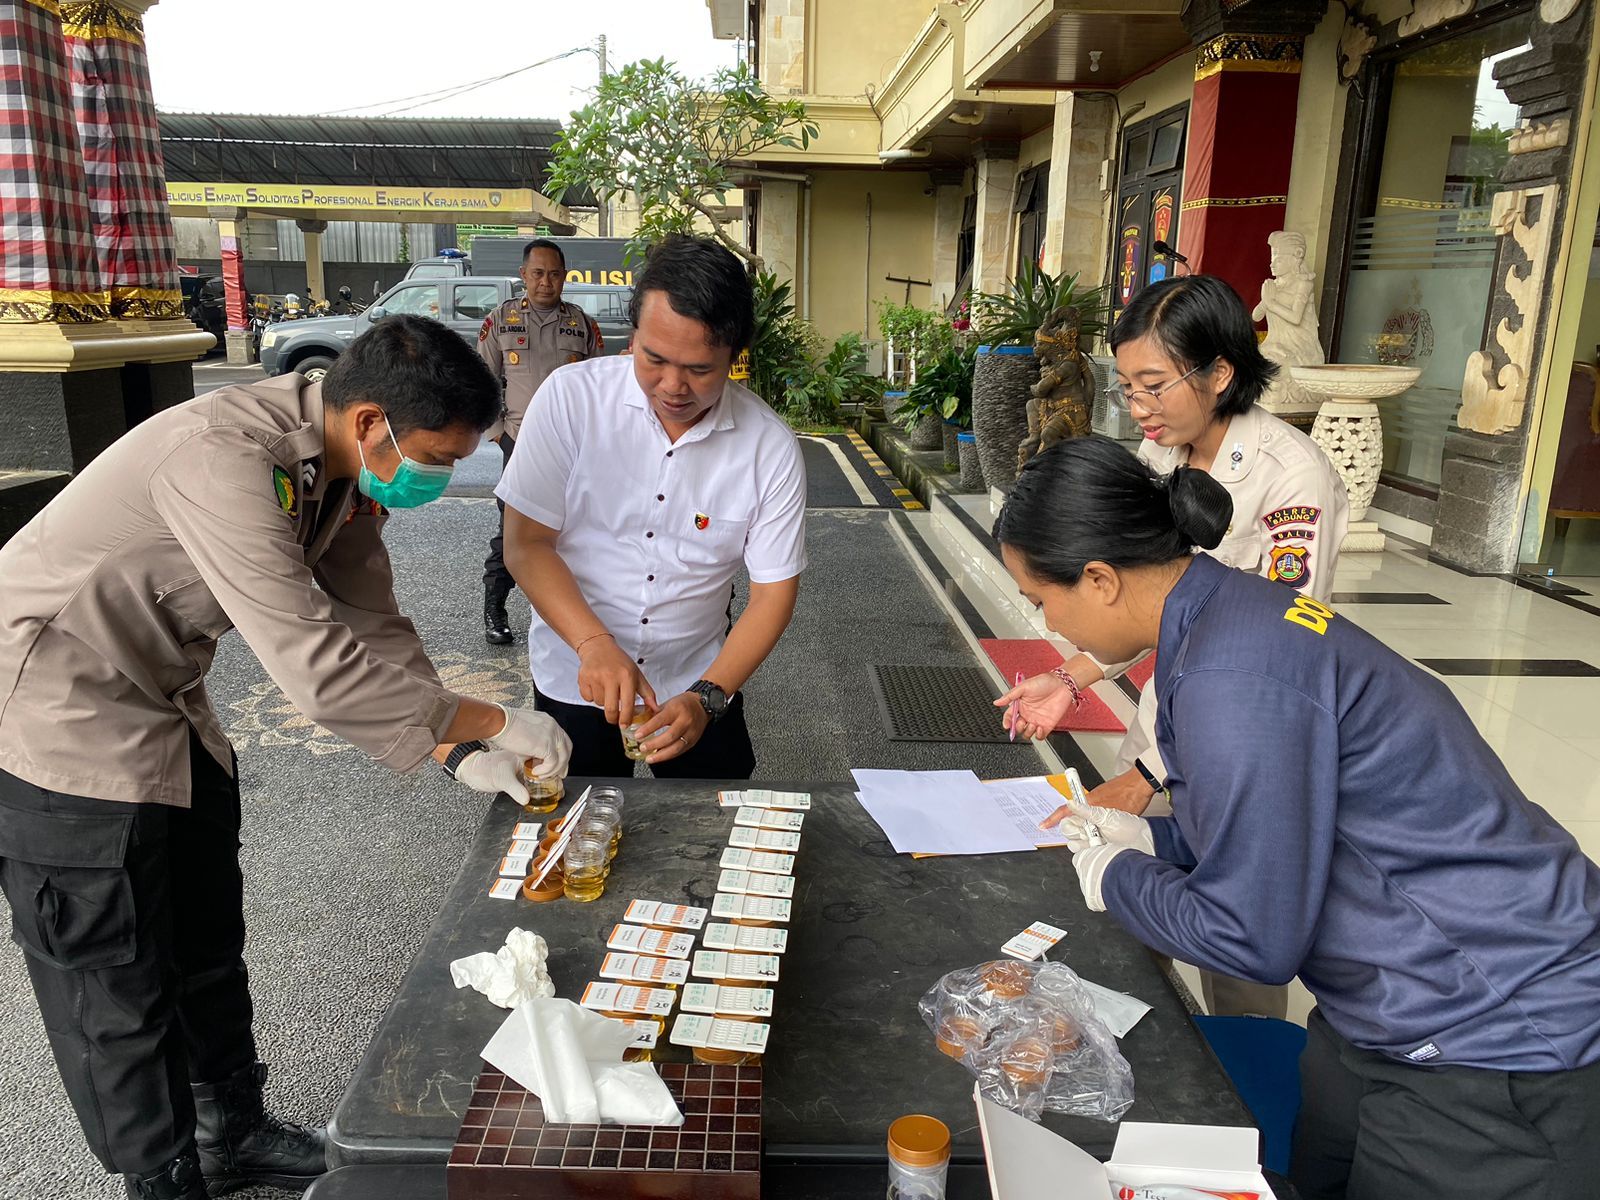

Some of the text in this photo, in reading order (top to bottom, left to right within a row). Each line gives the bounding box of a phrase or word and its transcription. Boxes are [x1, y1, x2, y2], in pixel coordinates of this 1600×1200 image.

[167, 192, 202, 201] ELIGIUS
[205, 187, 243, 203] EMPATI
[246, 188, 298, 204] SOLIDITAS
[302, 189, 373, 205] PROFESIONAL
[376, 191, 420, 207] ENERGIK
[423, 192, 458, 208] KERJA
[566, 270, 632, 286] OLISI
[1267, 508, 1315, 521] POLRES
[1273, 514, 1309, 525] BADUNG
